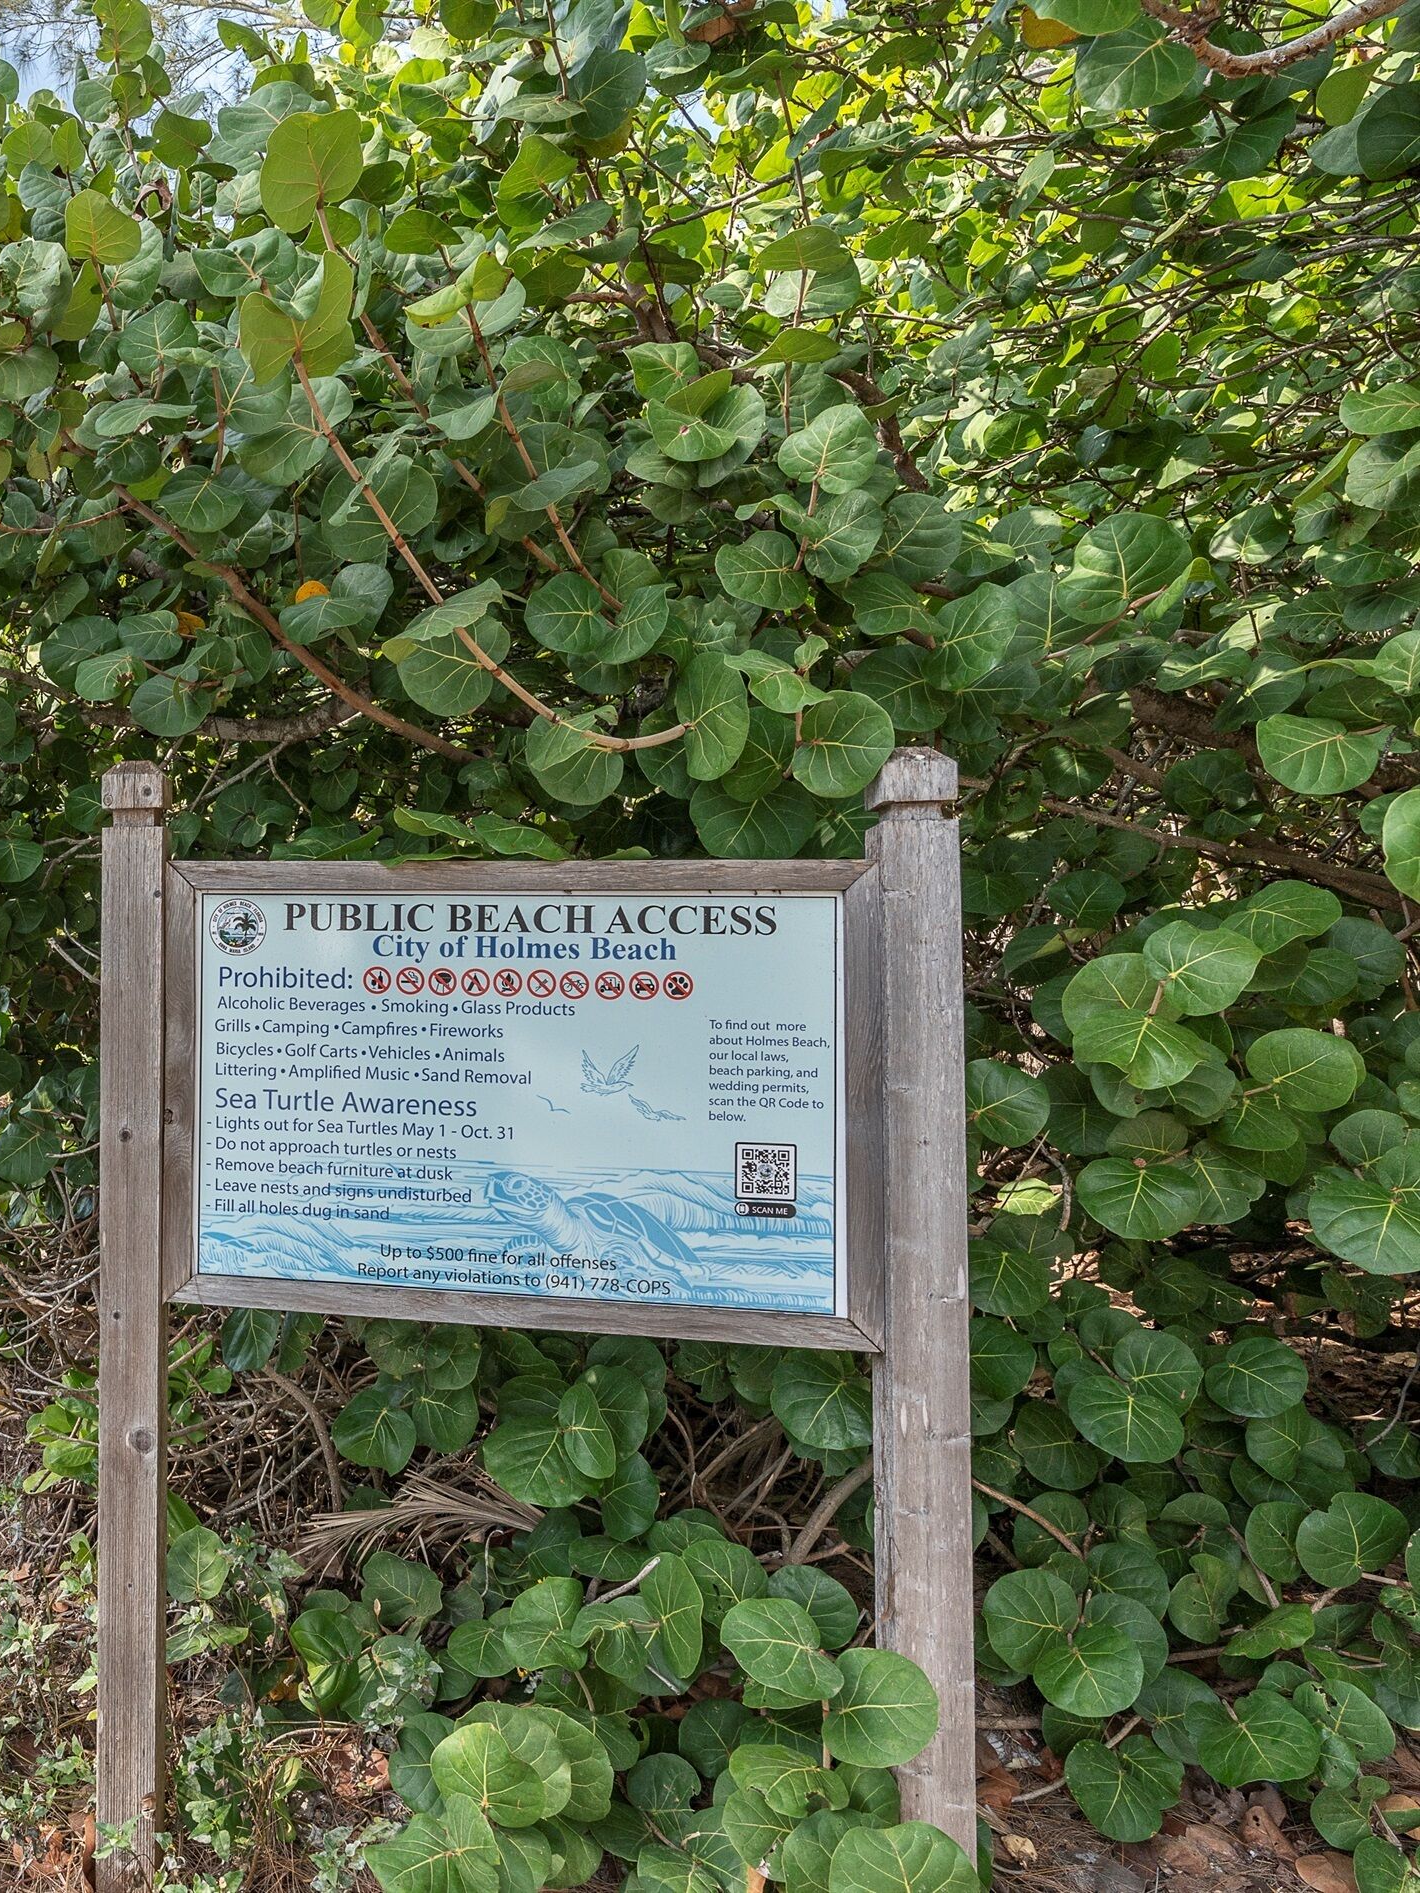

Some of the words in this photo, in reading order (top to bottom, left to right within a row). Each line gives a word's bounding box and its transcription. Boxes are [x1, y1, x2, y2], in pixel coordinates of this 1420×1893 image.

[282, 903, 435, 932] PUBLIC
[447, 904, 595, 934] BEACH
[605, 905, 778, 936] ACCESS
[372, 934, 429, 963] City
[439, 935, 468, 958] of
[475, 936, 580, 959] Holmes
[590, 937, 677, 960] Beach
[218, 966, 353, 989] Prohibited:
[217, 996, 285, 1011] Alcoholic
[289, 998, 365, 1015] Beverages
[381, 999, 448, 1016] Smoking
[461, 1000, 502, 1014] Glass
[506, 1002, 575, 1016] Products
[215, 1018, 251, 1033] Grills
[262, 1020, 329, 1037] Camping
[341, 1021, 417, 1038] Campfires
[429, 1023, 503, 1038] Fireworks
[709, 1019, 722, 1030] To
[725, 1020, 748, 1030] find
[751, 1021, 770, 1031] out
[776, 1022, 807, 1032] more
[216, 1042, 273, 1059] Bicycles
[285, 1043, 319, 1057] Golf
[320, 1045, 358, 1058] Carts
[369, 1046, 430, 1060] Vehicles
[443, 1047, 505, 1062] Animals
[709, 1035, 743, 1046] about
[746, 1036, 789, 1047] Holmes
[792, 1037, 830, 1048] Beach,
[709, 1051, 728, 1061] our
[731, 1050, 758, 1061] local
[761, 1051, 789, 1063] laws,
[215, 1062, 277, 1080] Littering
[288, 1064, 361, 1081] Amplified
[365, 1067, 410, 1081] Music
[422, 1068, 459, 1083] Sand
[464, 1069, 531, 1085] Removal
[709, 1065, 744, 1076] beach
[746, 1067, 794, 1080] parking,
[796, 1068, 818, 1078] and
[709, 1081, 759, 1093] wedding
[762, 1082, 809, 1095] permits,
[215, 1088, 257, 1110] Sea
[262, 1089, 334, 1112] Turtle
[341, 1092, 477, 1117] Awareness
[709, 1097, 734, 1106] scan
[737, 1096, 756, 1107] the
[759, 1098, 776, 1109] QR
[779, 1098, 809, 1109] Code
[812, 1099, 824, 1109] to
[709, 1111, 746, 1122] below.
[216, 1116, 259, 1133] Lights
[264, 1119, 289, 1132] out
[292, 1117, 313, 1133] for
[317, 1120, 344, 1134] Sea
[347, 1120, 398, 1136] Turtles
[403, 1122, 434, 1141] May
[439, 1123, 445, 1137] 1
[461, 1125, 493, 1140] Oct.
[496, 1126, 514, 1140] 31
[216, 1137, 236, 1151] Do
[240, 1139, 265, 1152] not
[269, 1140, 339, 1160] approach
[343, 1142, 392, 1157] turtles
[396, 1146, 412, 1158] or
[416, 1146, 456, 1159] nests
[215, 1157, 274, 1173] Remove
[278, 1159, 323, 1175] beach
[327, 1161, 393, 1178] furniture
[397, 1165, 412, 1179] at
[416, 1165, 452, 1181] dusk
[215, 1178, 257, 1193] Leave
[261, 1181, 299, 1195] nests
[303, 1181, 331, 1196] and
[335, 1183, 374, 1201] signs
[378, 1185, 471, 1203] undisturbed
[214, 1198, 235, 1212] Fill
[238, 1199, 255, 1213] all
[259, 1200, 298, 1215] holes
[302, 1202, 331, 1220] dug
[336, 1204, 350, 1218] in
[354, 1205, 389, 1221] sand
[751, 1206, 774, 1214] SCAN
[776, 1207, 788, 1215] ME
[380, 1244, 402, 1260] Up
[406, 1246, 422, 1260] to
[426, 1246, 464, 1262] $500
[467, 1248, 497, 1265] fine
[501, 1250, 523, 1267] for
[527, 1251, 545, 1267] all
[549, 1253, 617, 1271] offenses
[357, 1262, 409, 1280] Report
[413, 1268, 440, 1284] any
[444, 1268, 519, 1287] violations
[524, 1274, 541, 1287] to
[545, 1274, 585, 1292] (941)
[590, 1276, 671, 1295] 778-COPS
